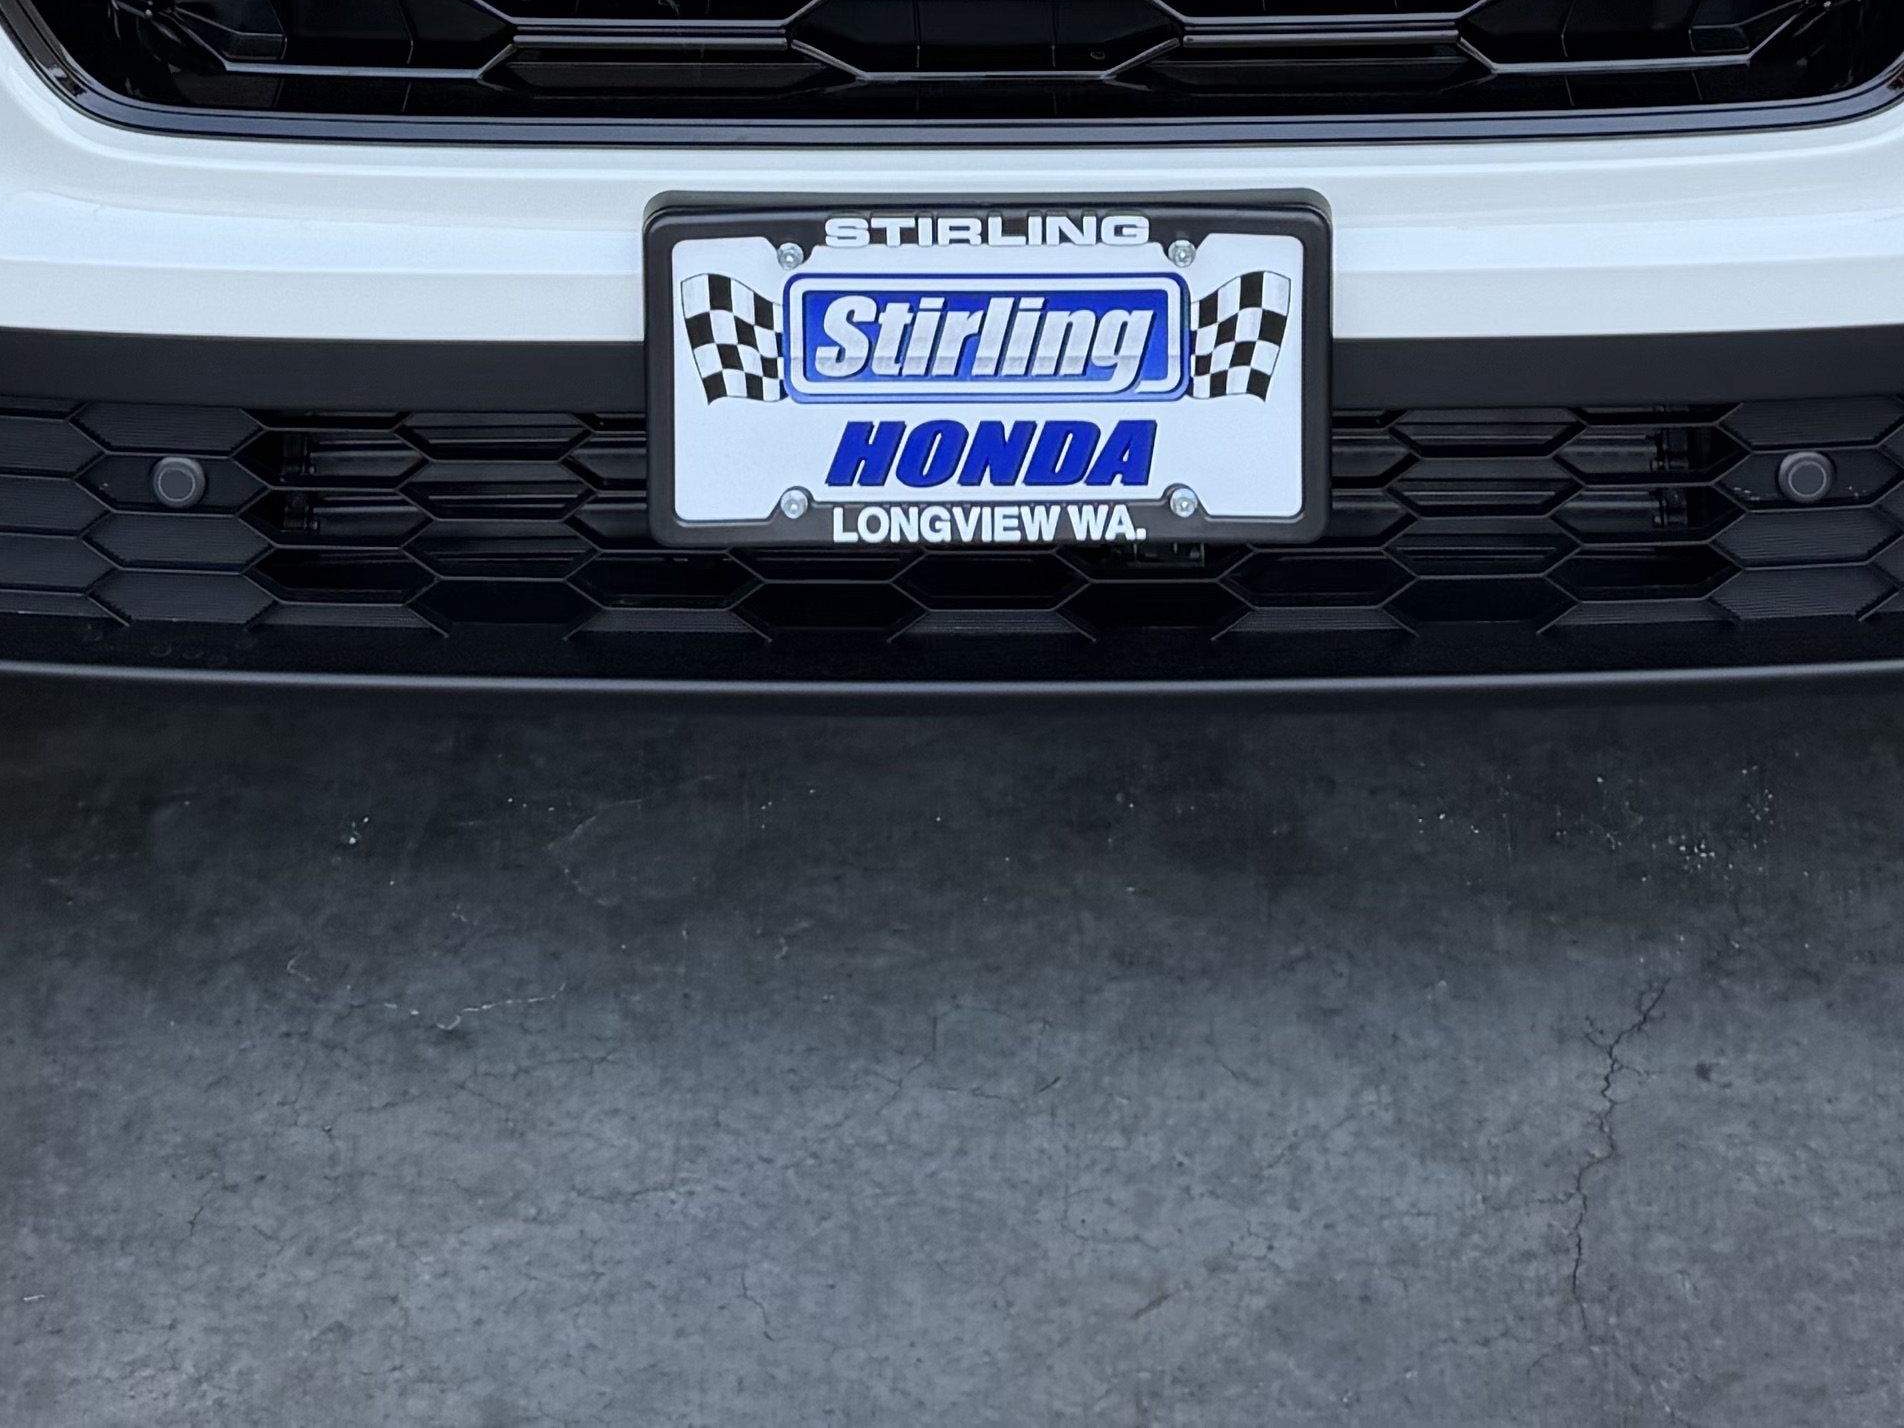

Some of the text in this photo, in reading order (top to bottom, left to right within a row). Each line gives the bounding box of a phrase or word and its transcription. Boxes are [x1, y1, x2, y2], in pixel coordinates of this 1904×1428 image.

[825, 216, 1151, 247] STIRLING
[814, 295, 1154, 394] Stirling
[825, 419, 1158, 487] HONDA
[833, 506, 1147, 542] LONGVIEW WA.
